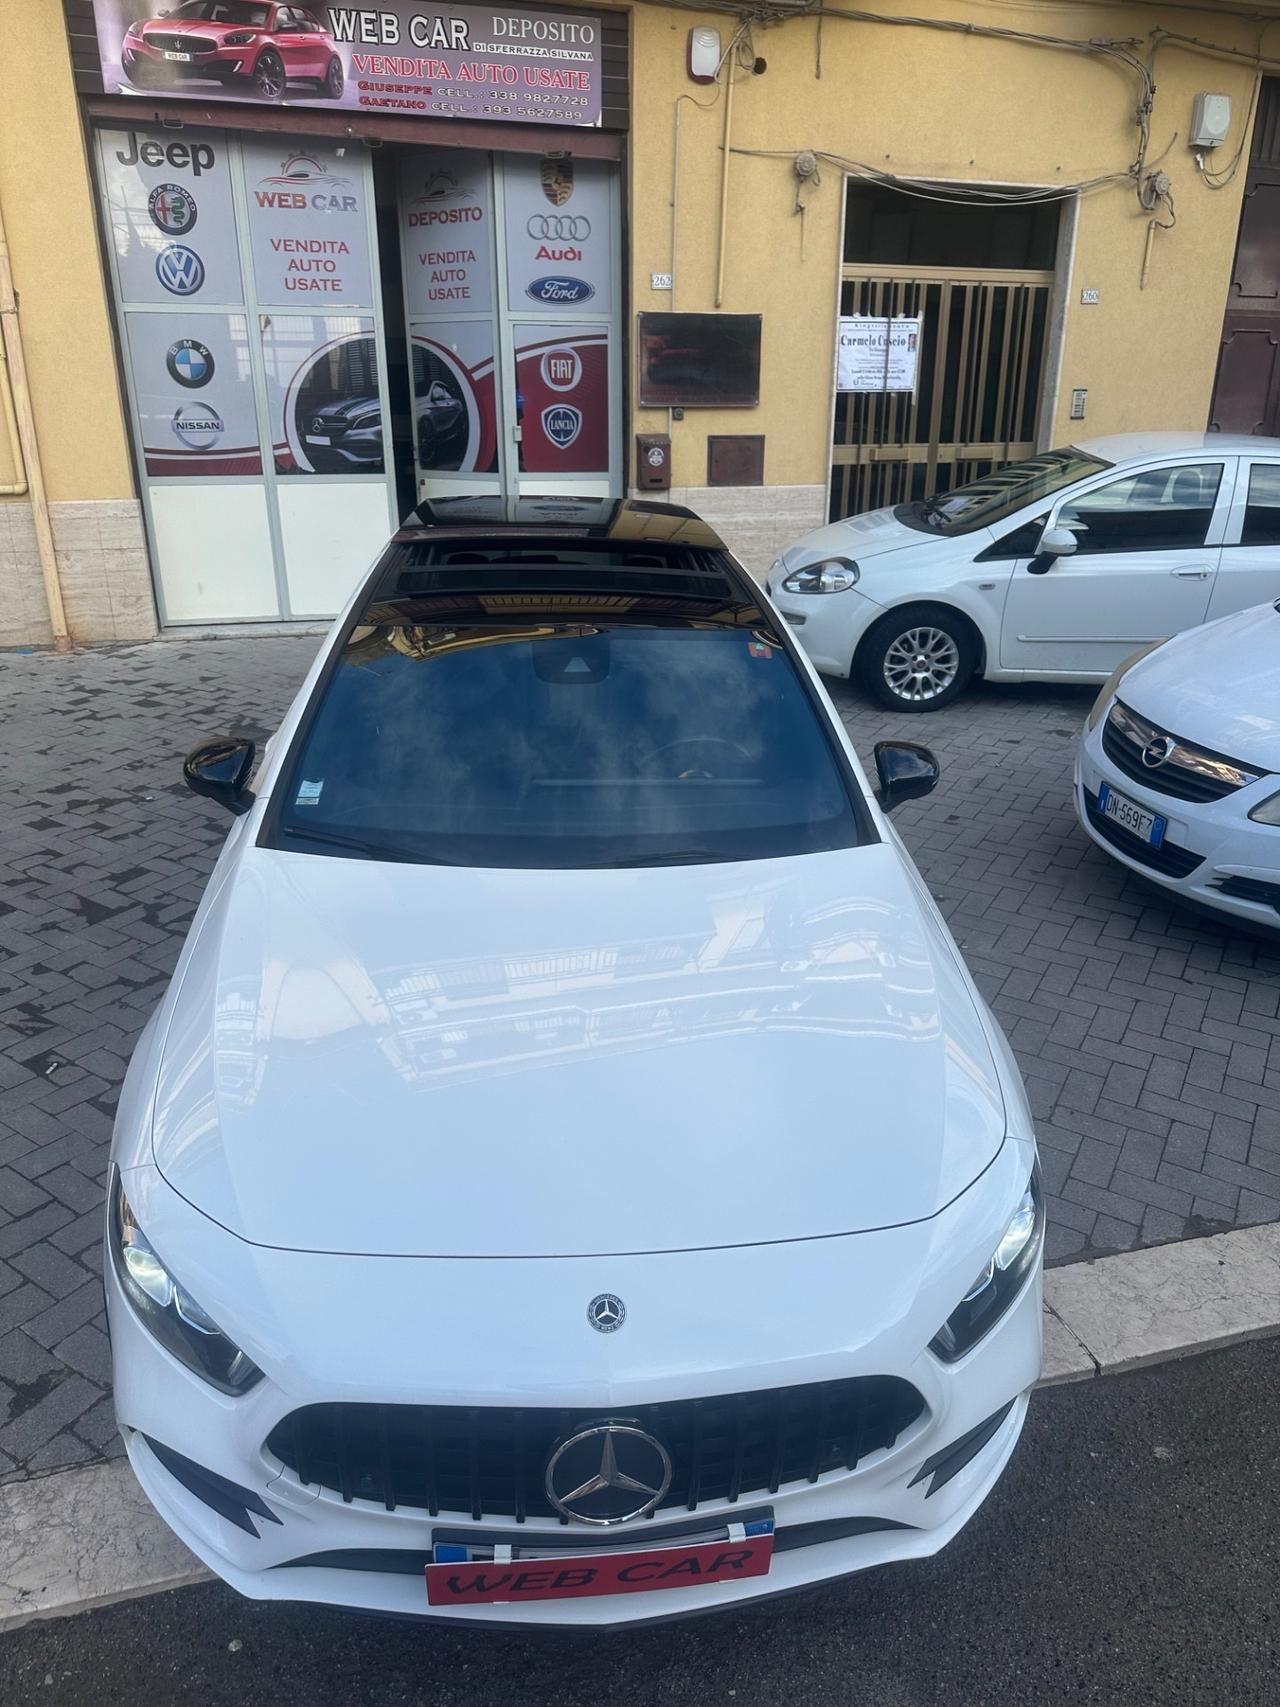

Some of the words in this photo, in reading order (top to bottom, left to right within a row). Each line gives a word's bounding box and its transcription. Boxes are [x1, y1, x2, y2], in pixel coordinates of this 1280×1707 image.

[327, 7, 400, 45] WEB
[408, 14, 471, 51] CAR
[492, 16, 595, 44] DEPOSITO
[474, 42, 486, 52] DI
[488, 44, 549, 57] SFERRAZZA
[550, 49, 593, 60] SILVANA
[352, 53, 452, 80] VENDITA
[456, 62, 518, 85] AUTO
[523, 67, 590, 91] USATE
[358, 80, 433, 95] GIUSEPPE
[490, 90, 518, 100] 338
[523, 93, 588, 106] 9827728
[359, 96, 427, 109] GAETANO
[484, 104, 511, 114] 393
[517, 107, 582, 120] 5627589
[116, 131, 215, 176] Jeep
[166, 184, 196, 212] ROMEO
[254, 191, 307, 209] WEB
[311, 194, 358, 212] CAR
[408, 206, 482, 227] DEPOSITO
[270, 238, 350, 254] VENDITA
[535, 245, 582, 261] Audi
[288, 258, 336, 273] AUTO
[418, 250, 476, 265] VENDITA
[284, 277, 343, 292] USATE
[431, 269, 466, 283] AUTO
[654, 275, 672, 287] 262
[428, 287, 471, 300] USATE
[541, 280, 579, 299] Ford
[169, 340, 208, 357] BMW
[841, 334, 877, 346] Carmelo
[550, 359, 573, 379] FIAT
[176, 422, 220, 430] NISSAN
[550, 419, 574, 430] LANCIA
[447, 1567, 598, 1594] WEB
[617, 1550, 754, 1583] CAR
